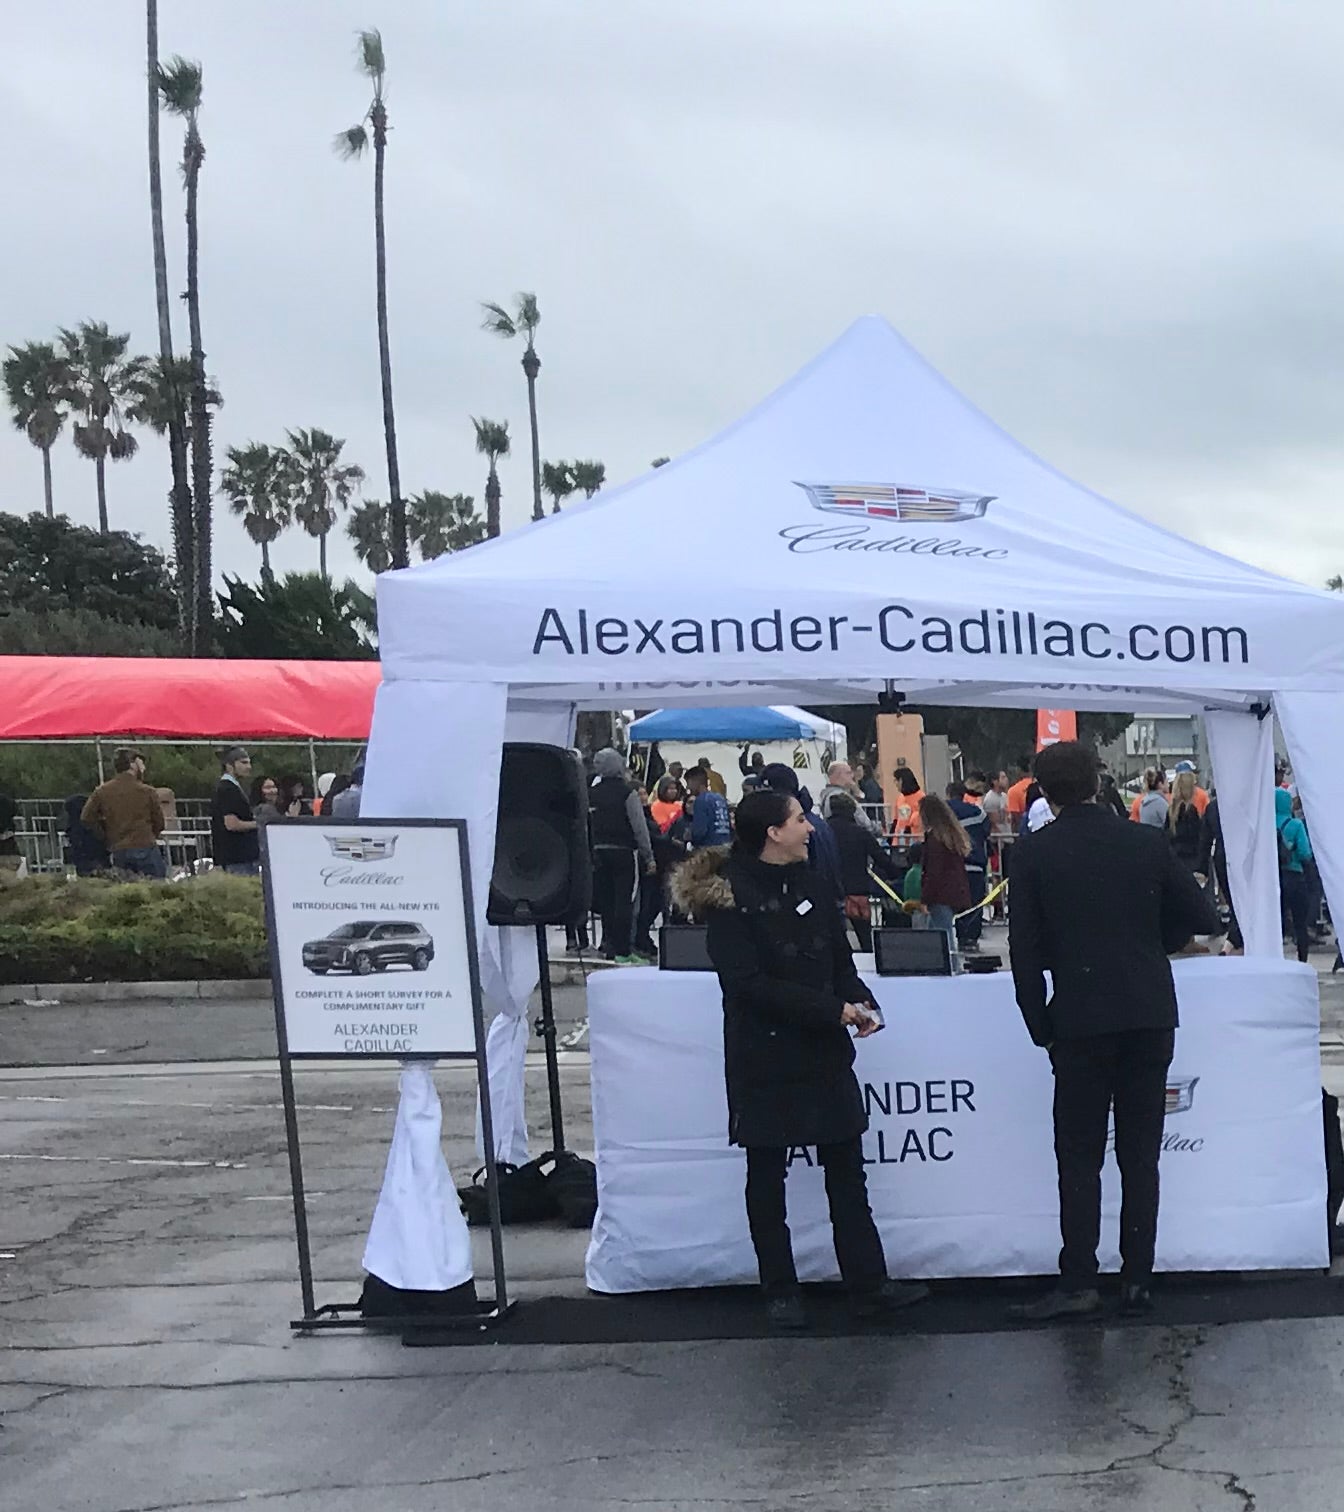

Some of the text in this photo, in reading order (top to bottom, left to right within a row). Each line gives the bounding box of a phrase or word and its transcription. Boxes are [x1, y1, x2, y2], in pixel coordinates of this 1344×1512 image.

[778, 523, 1009, 560] Cadillac
[533, 606, 1249, 664] Alexander-Cadillac.com
[320, 866, 405, 887] Cadillac
[292, 902, 358, 910] INTRODUCING
[360, 902, 377, 910] THE
[380, 902, 421, 911] ALL-NEW
[295, 990, 452, 999] COMPLETE A SHORT SURVEY FOR A
[323, 1003, 425, 1011] COMPLIMENTARY GIFT
[334, 1023, 418, 1036] ALEXANDER
[344, 1039, 412, 1052] CADILLAC
